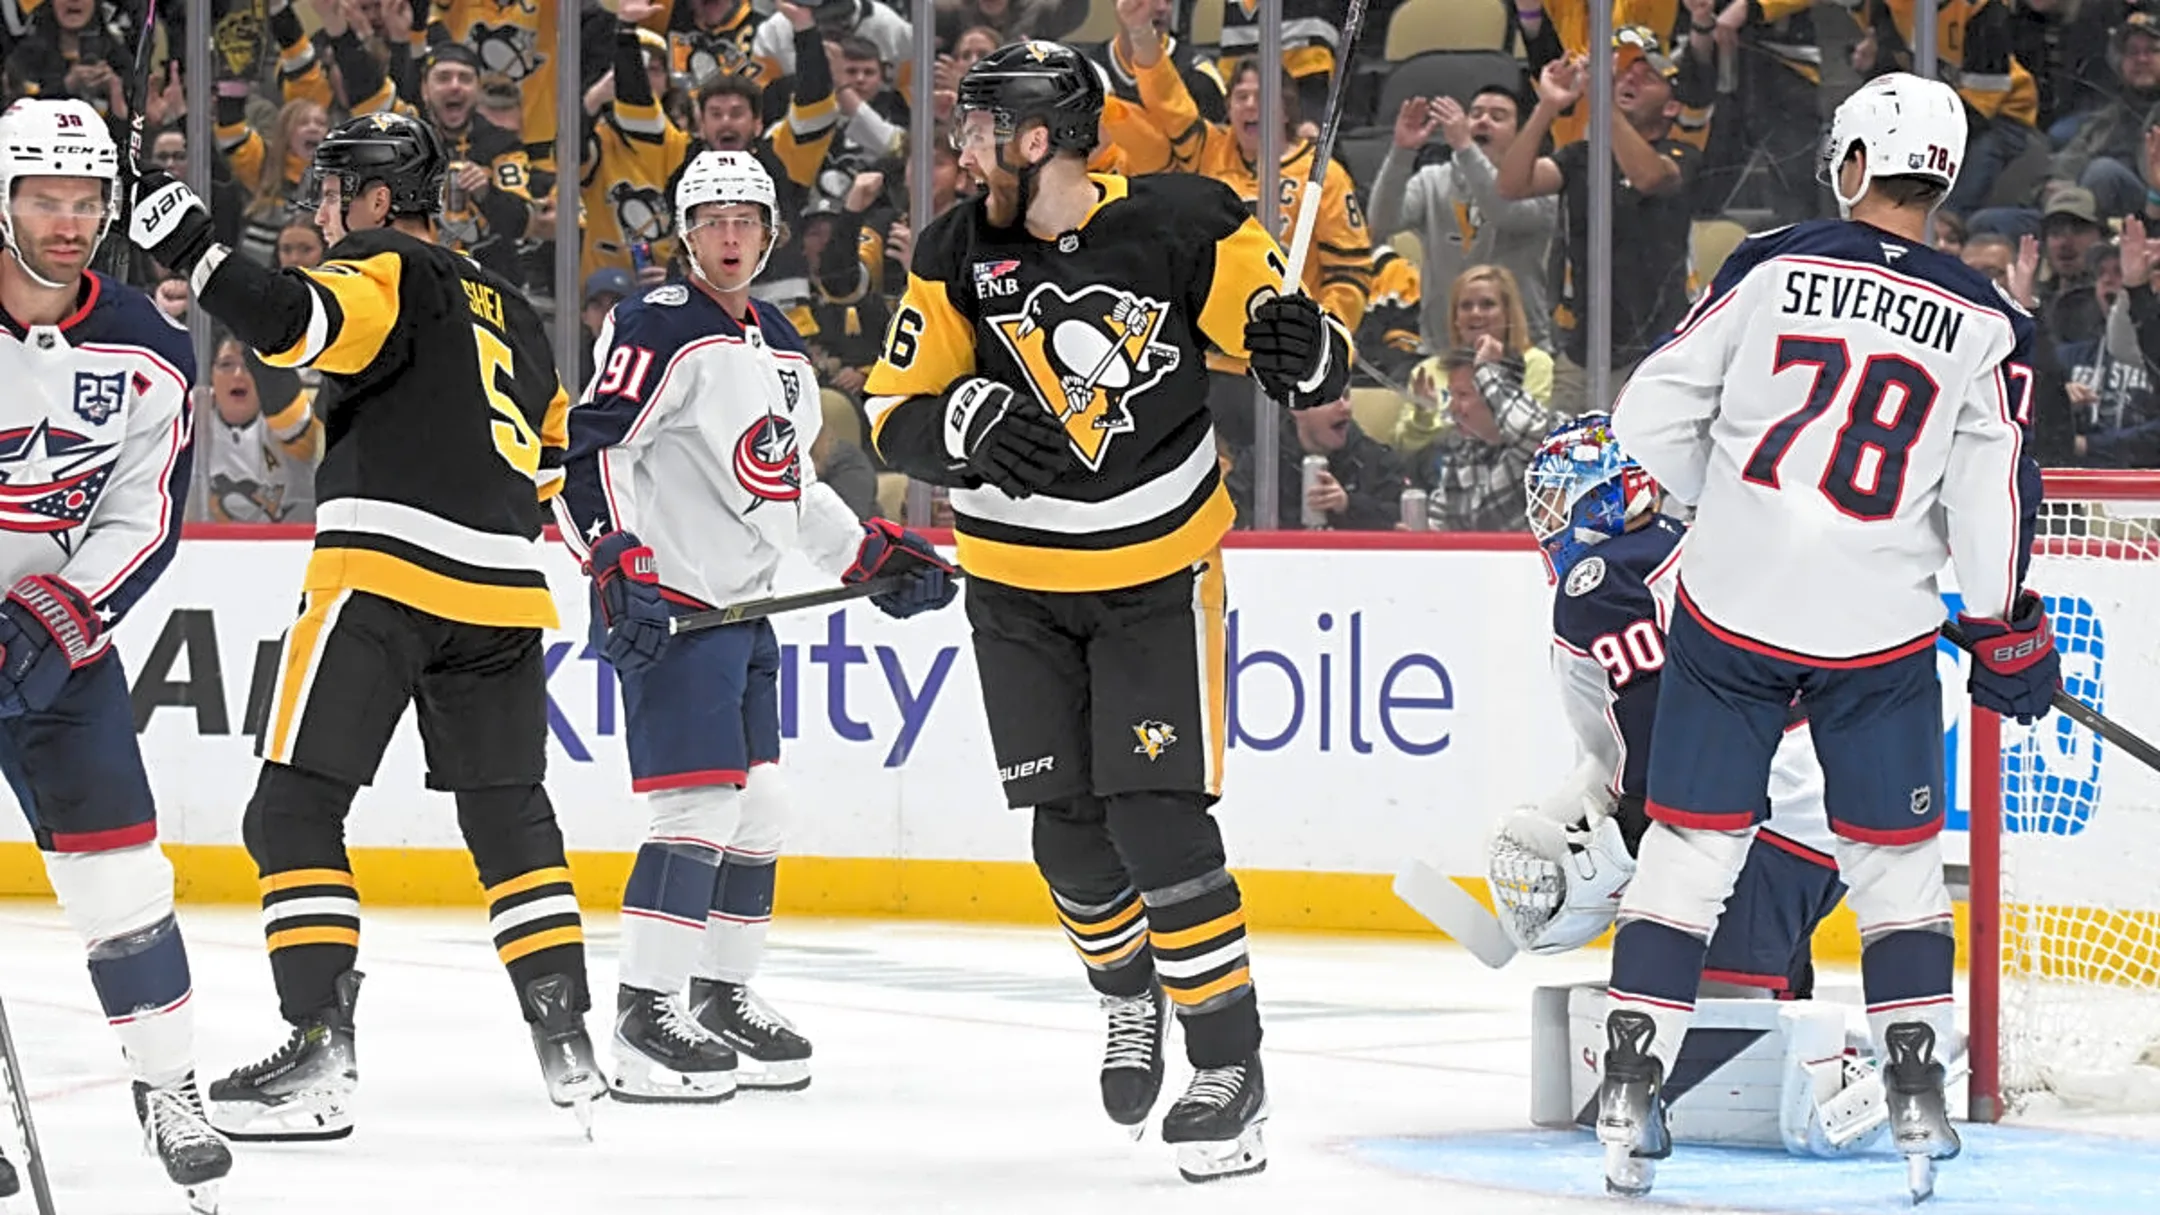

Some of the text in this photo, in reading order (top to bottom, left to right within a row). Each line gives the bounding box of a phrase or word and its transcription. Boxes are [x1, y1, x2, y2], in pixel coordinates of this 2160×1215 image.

[53, 145, 94, 154] CCM
[1927, 144, 1949, 171] 78
[461, 277, 506, 333] SHEA
[1782, 270, 1965, 353] SEVERSON
[78, 378, 120, 411] 25
[471, 323, 542, 479] 5
[598, 345, 657, 402] 91
[1742, 334, 1940, 522] 78
[1592, 619, 1667, 687] 90
[1993, 623, 2052, 663] BAU
[999, 756, 1055, 782] AUER
